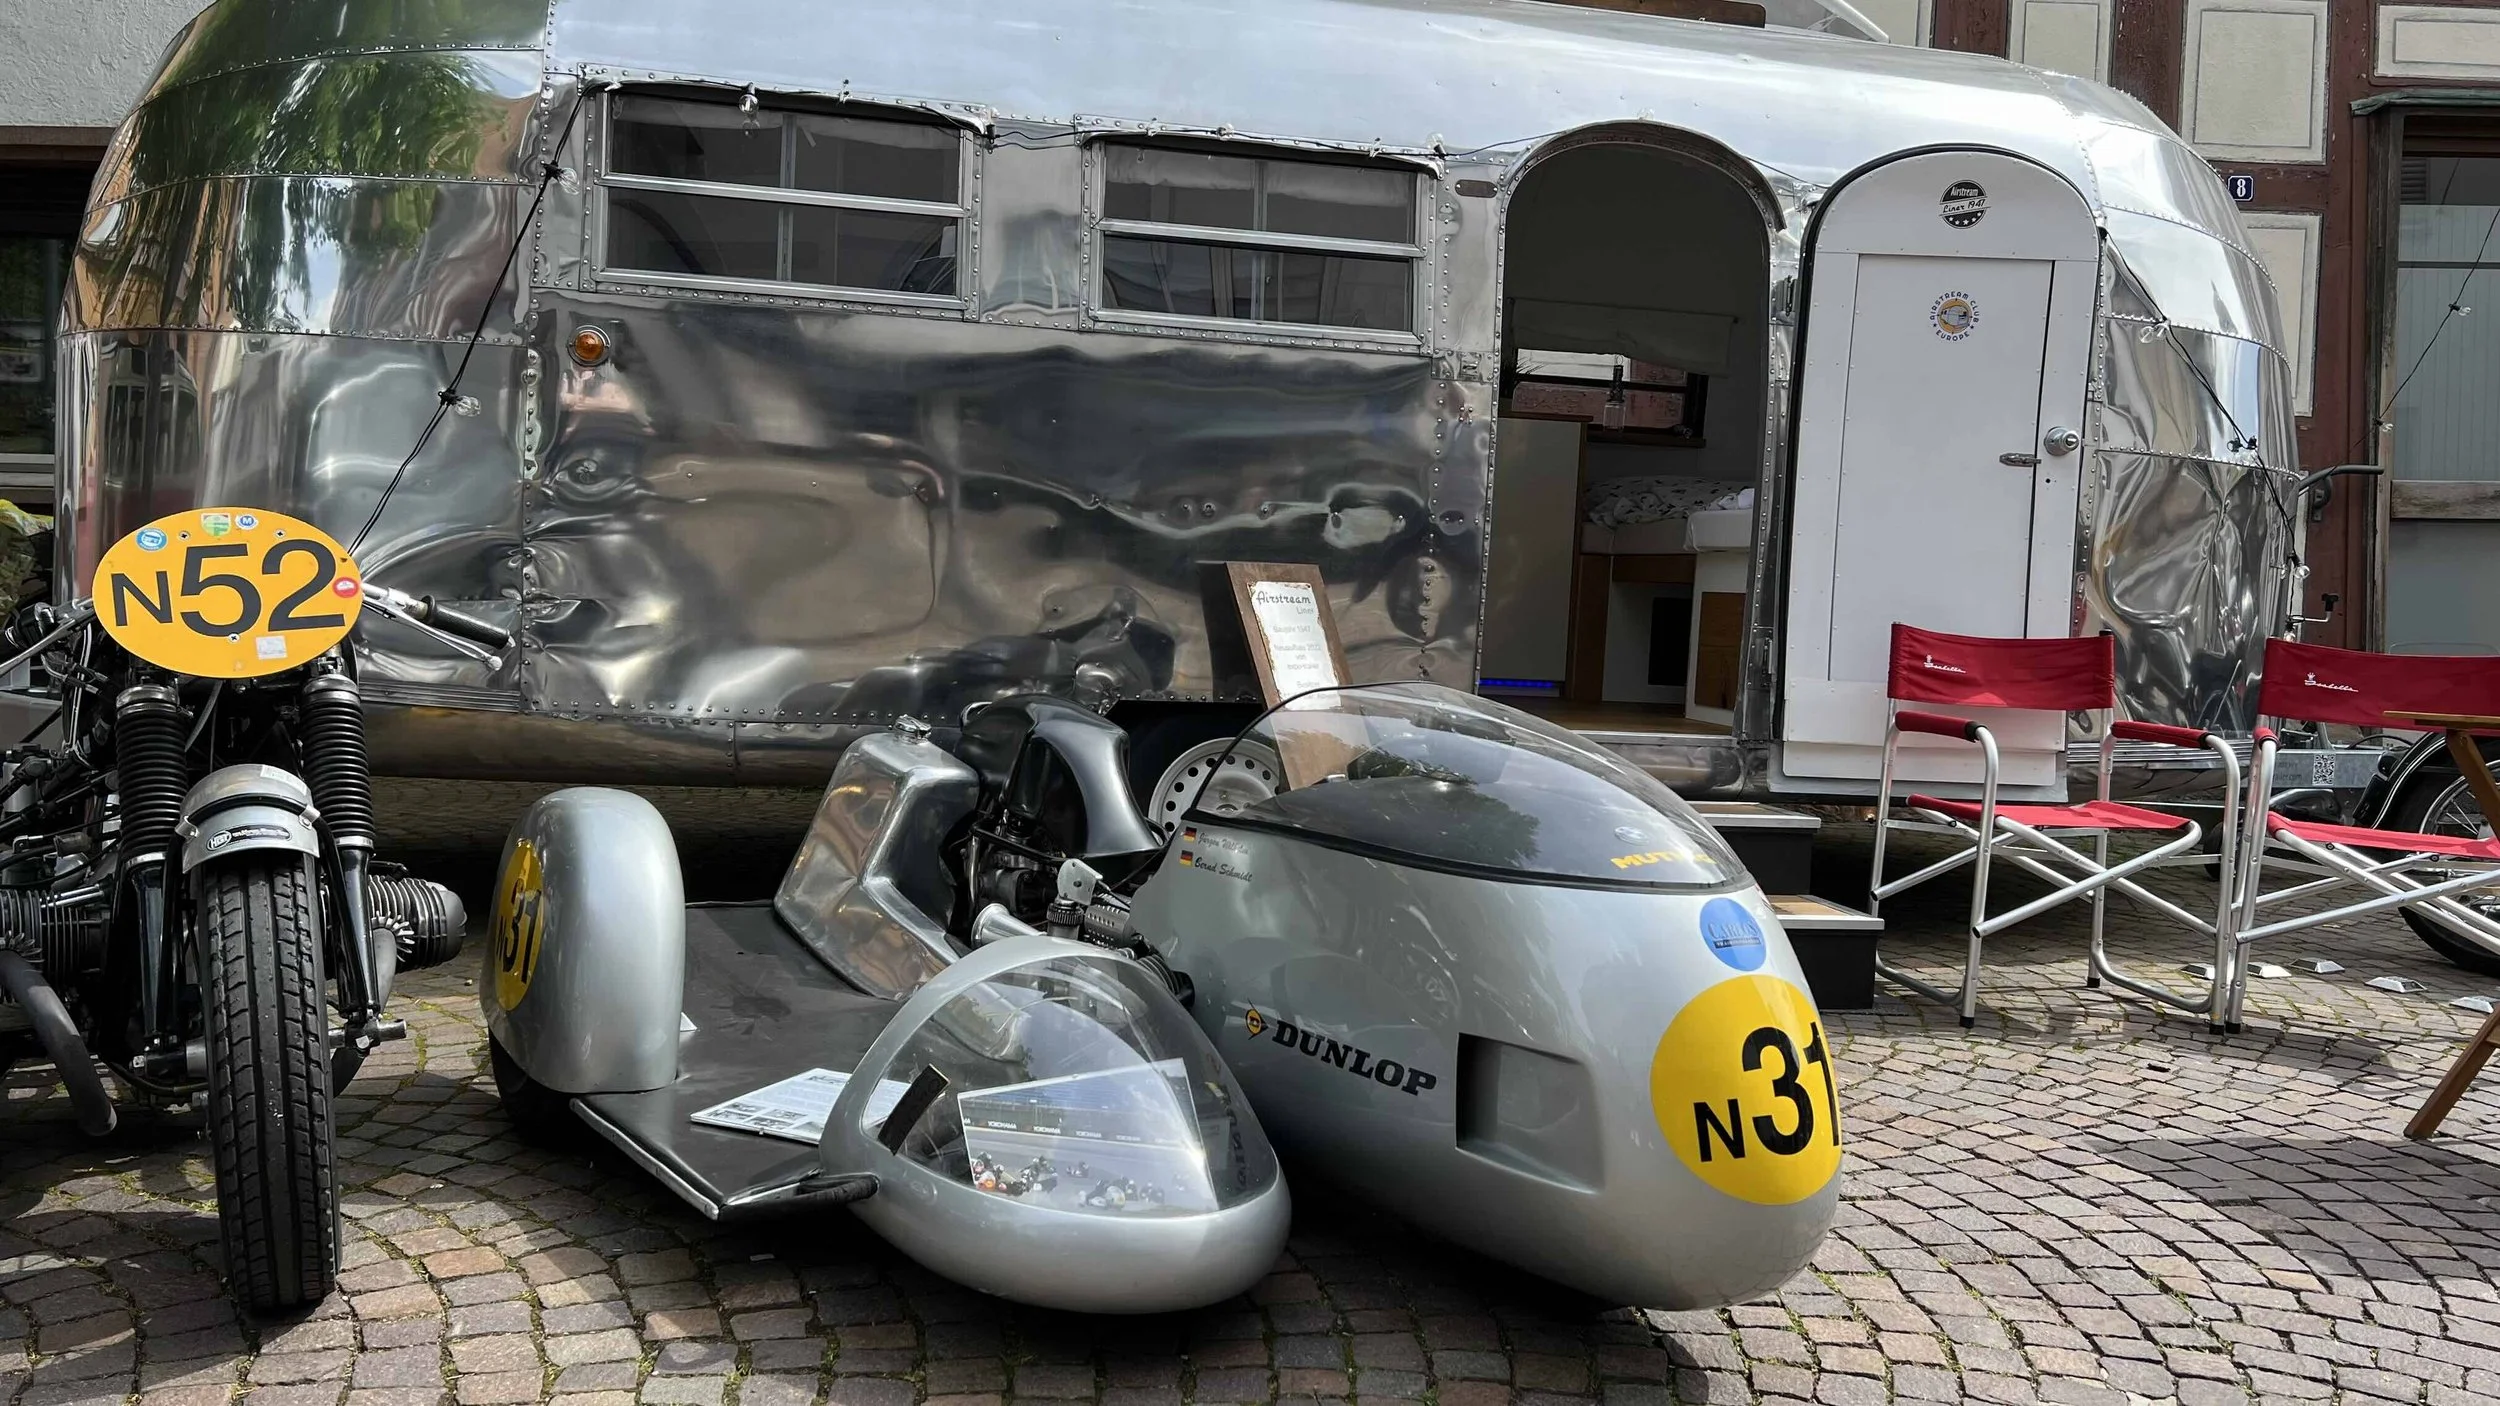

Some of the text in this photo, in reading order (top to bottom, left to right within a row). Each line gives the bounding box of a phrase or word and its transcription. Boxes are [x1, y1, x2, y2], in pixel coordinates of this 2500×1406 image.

[1950, 186, 1979, 197] Airstream
[2237, 179, 2246, 197] 8
[1943, 199, 1986, 213] Liner 1947
[1930, 291, 1980, 323] AIRSTREAM CLUB
[1936, 329, 1970, 341] EUROPE
[111, 539, 345, 637] N52
[1256, 590, 1312, 605] Airstream
[1195, 856, 1217, 873] Bernd
[1219, 863, 1253, 882] Schmidt
[1272, 1020, 1437, 1096] DUNLOP
[1693, 1021, 1840, 1163] N31
